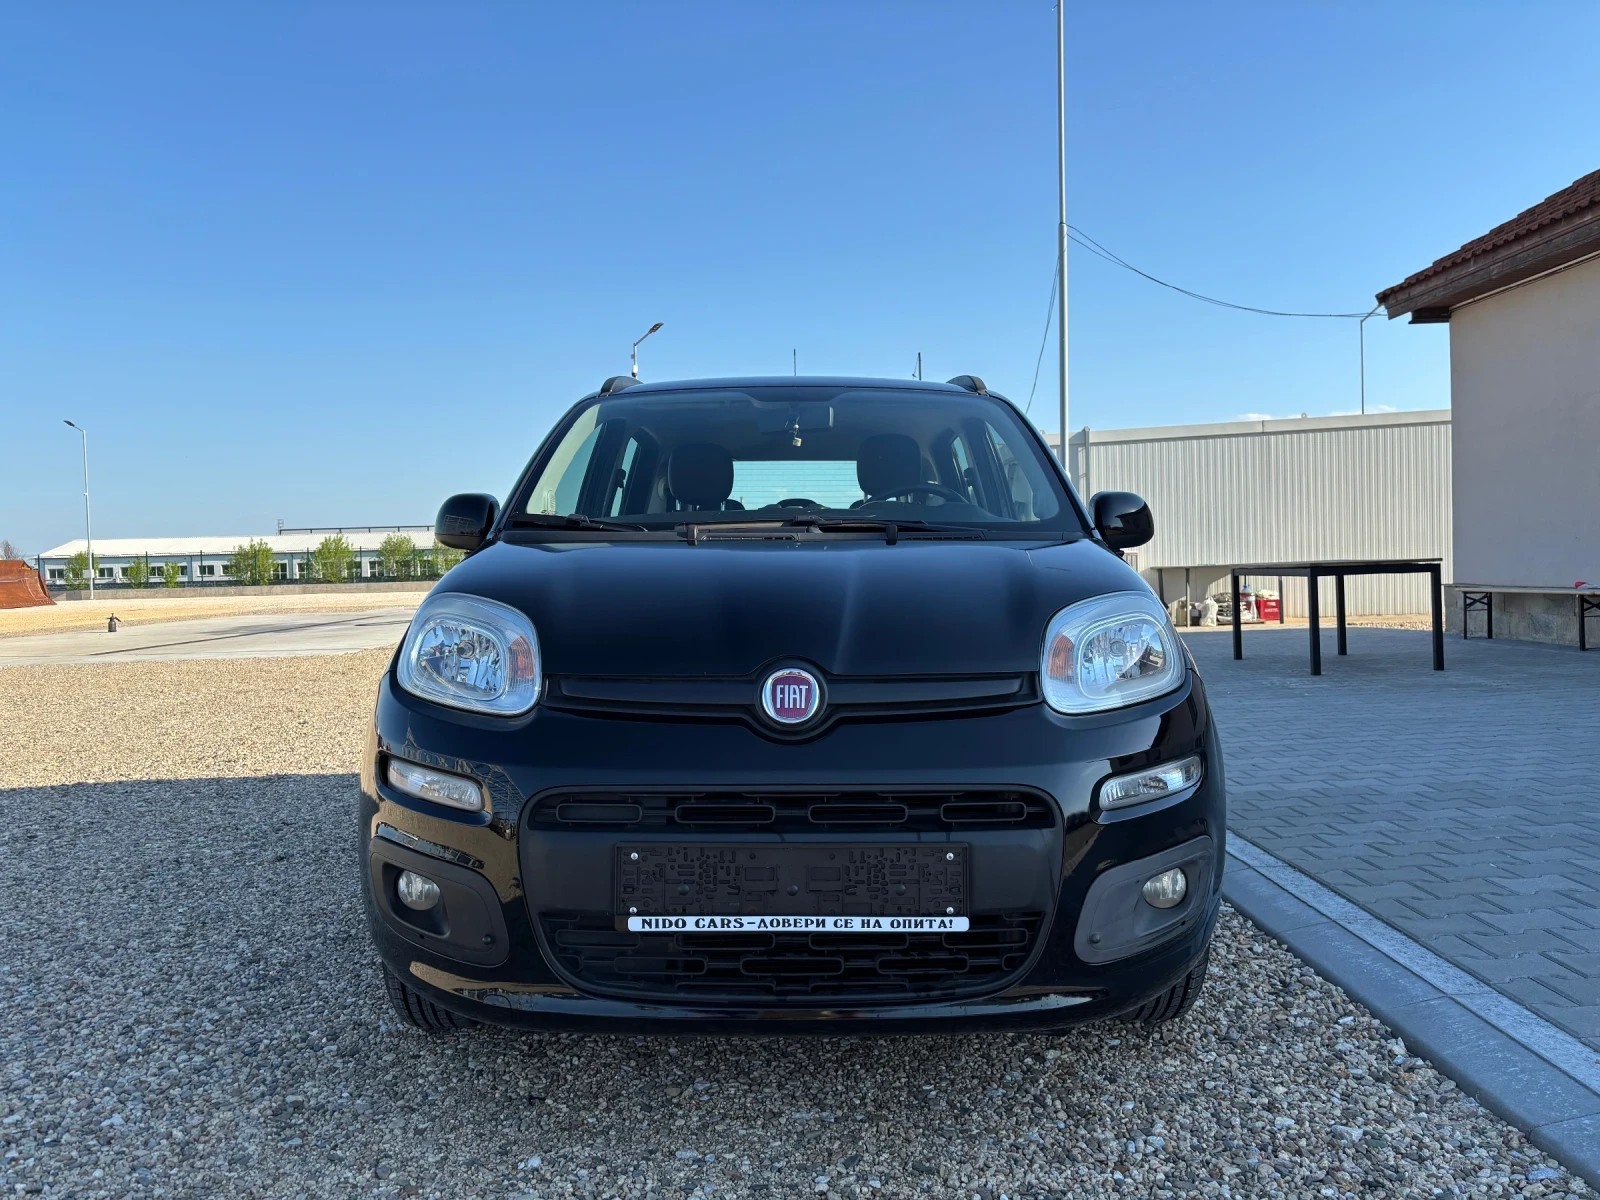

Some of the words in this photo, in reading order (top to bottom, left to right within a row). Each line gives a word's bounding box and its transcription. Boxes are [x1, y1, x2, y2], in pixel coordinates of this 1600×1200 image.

[776, 684, 808, 709] FIAT
[641, 918, 687, 929] NIDO
[833, 918, 854, 929] СЕ
[860, 918, 882, 929] НА
[889, 918, 953, 929] ОПИТА!
